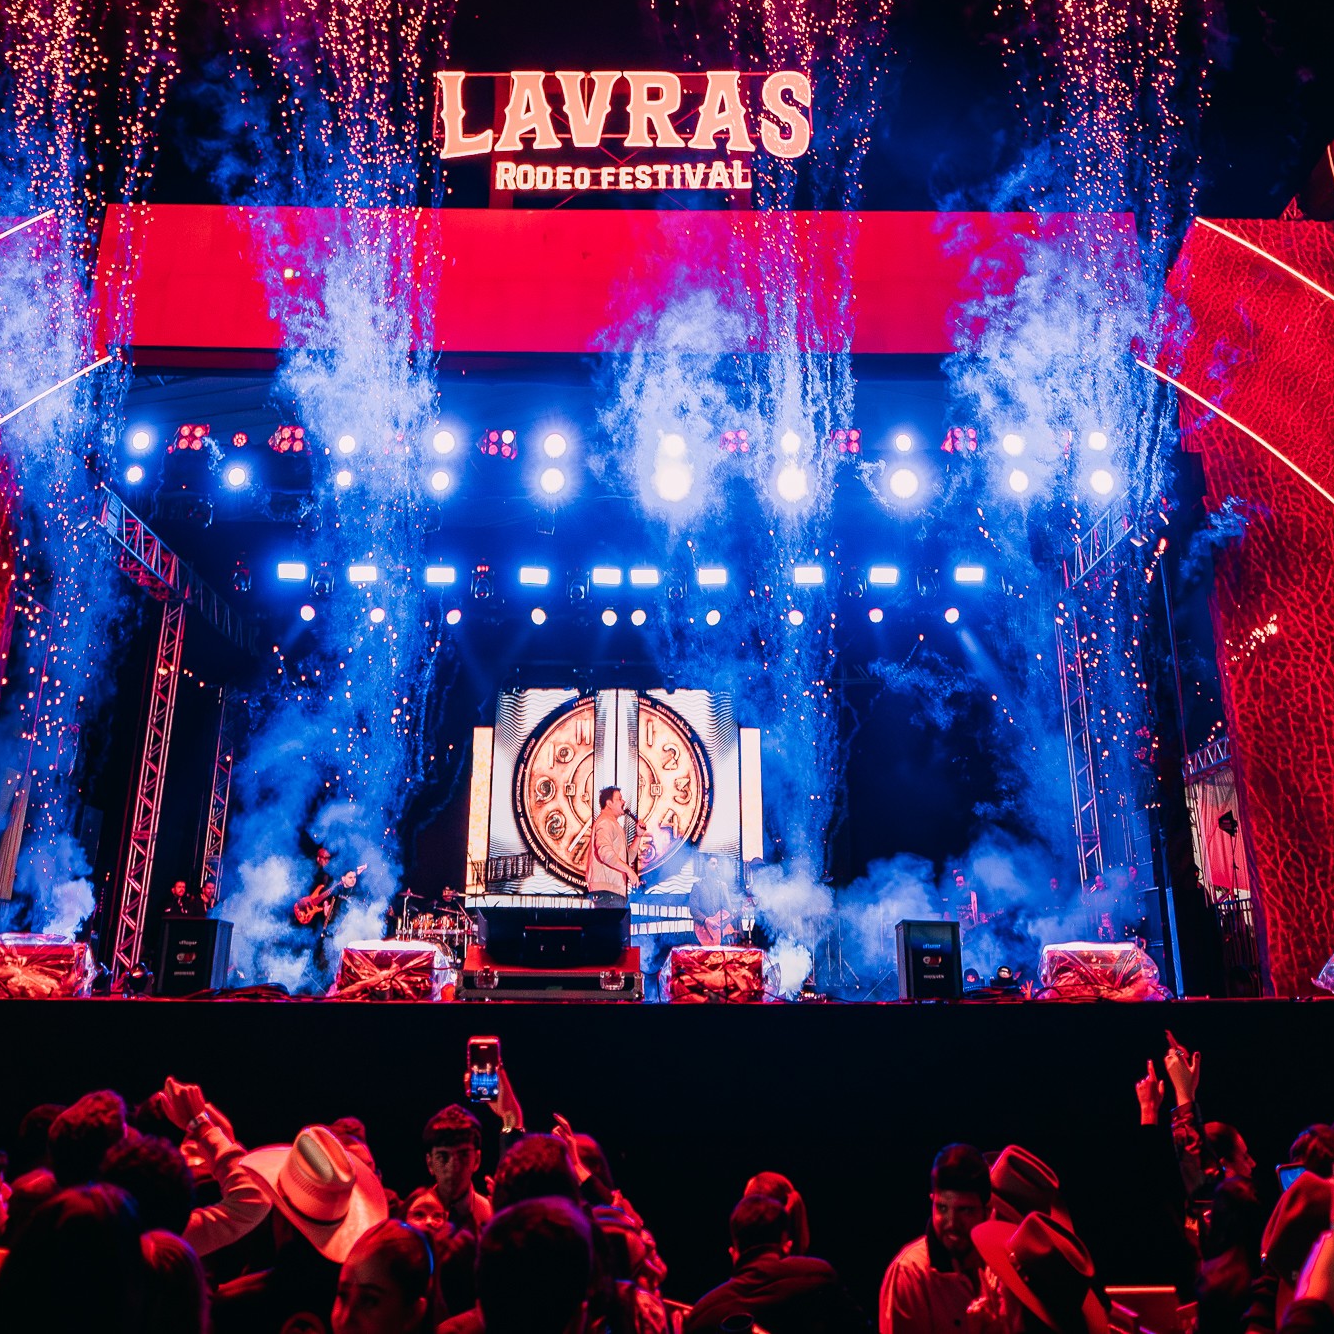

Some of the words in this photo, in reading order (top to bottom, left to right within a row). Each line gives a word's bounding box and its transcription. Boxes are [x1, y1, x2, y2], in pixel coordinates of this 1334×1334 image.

[436, 71, 812, 159] LAVRAS
[494, 161, 591, 191] RODEO
[600, 160, 753, 190] FESTIVAL
[662, 742, 681, 771] 2
[673, 776, 693, 805] 3
[658, 807, 680, 840] 4
